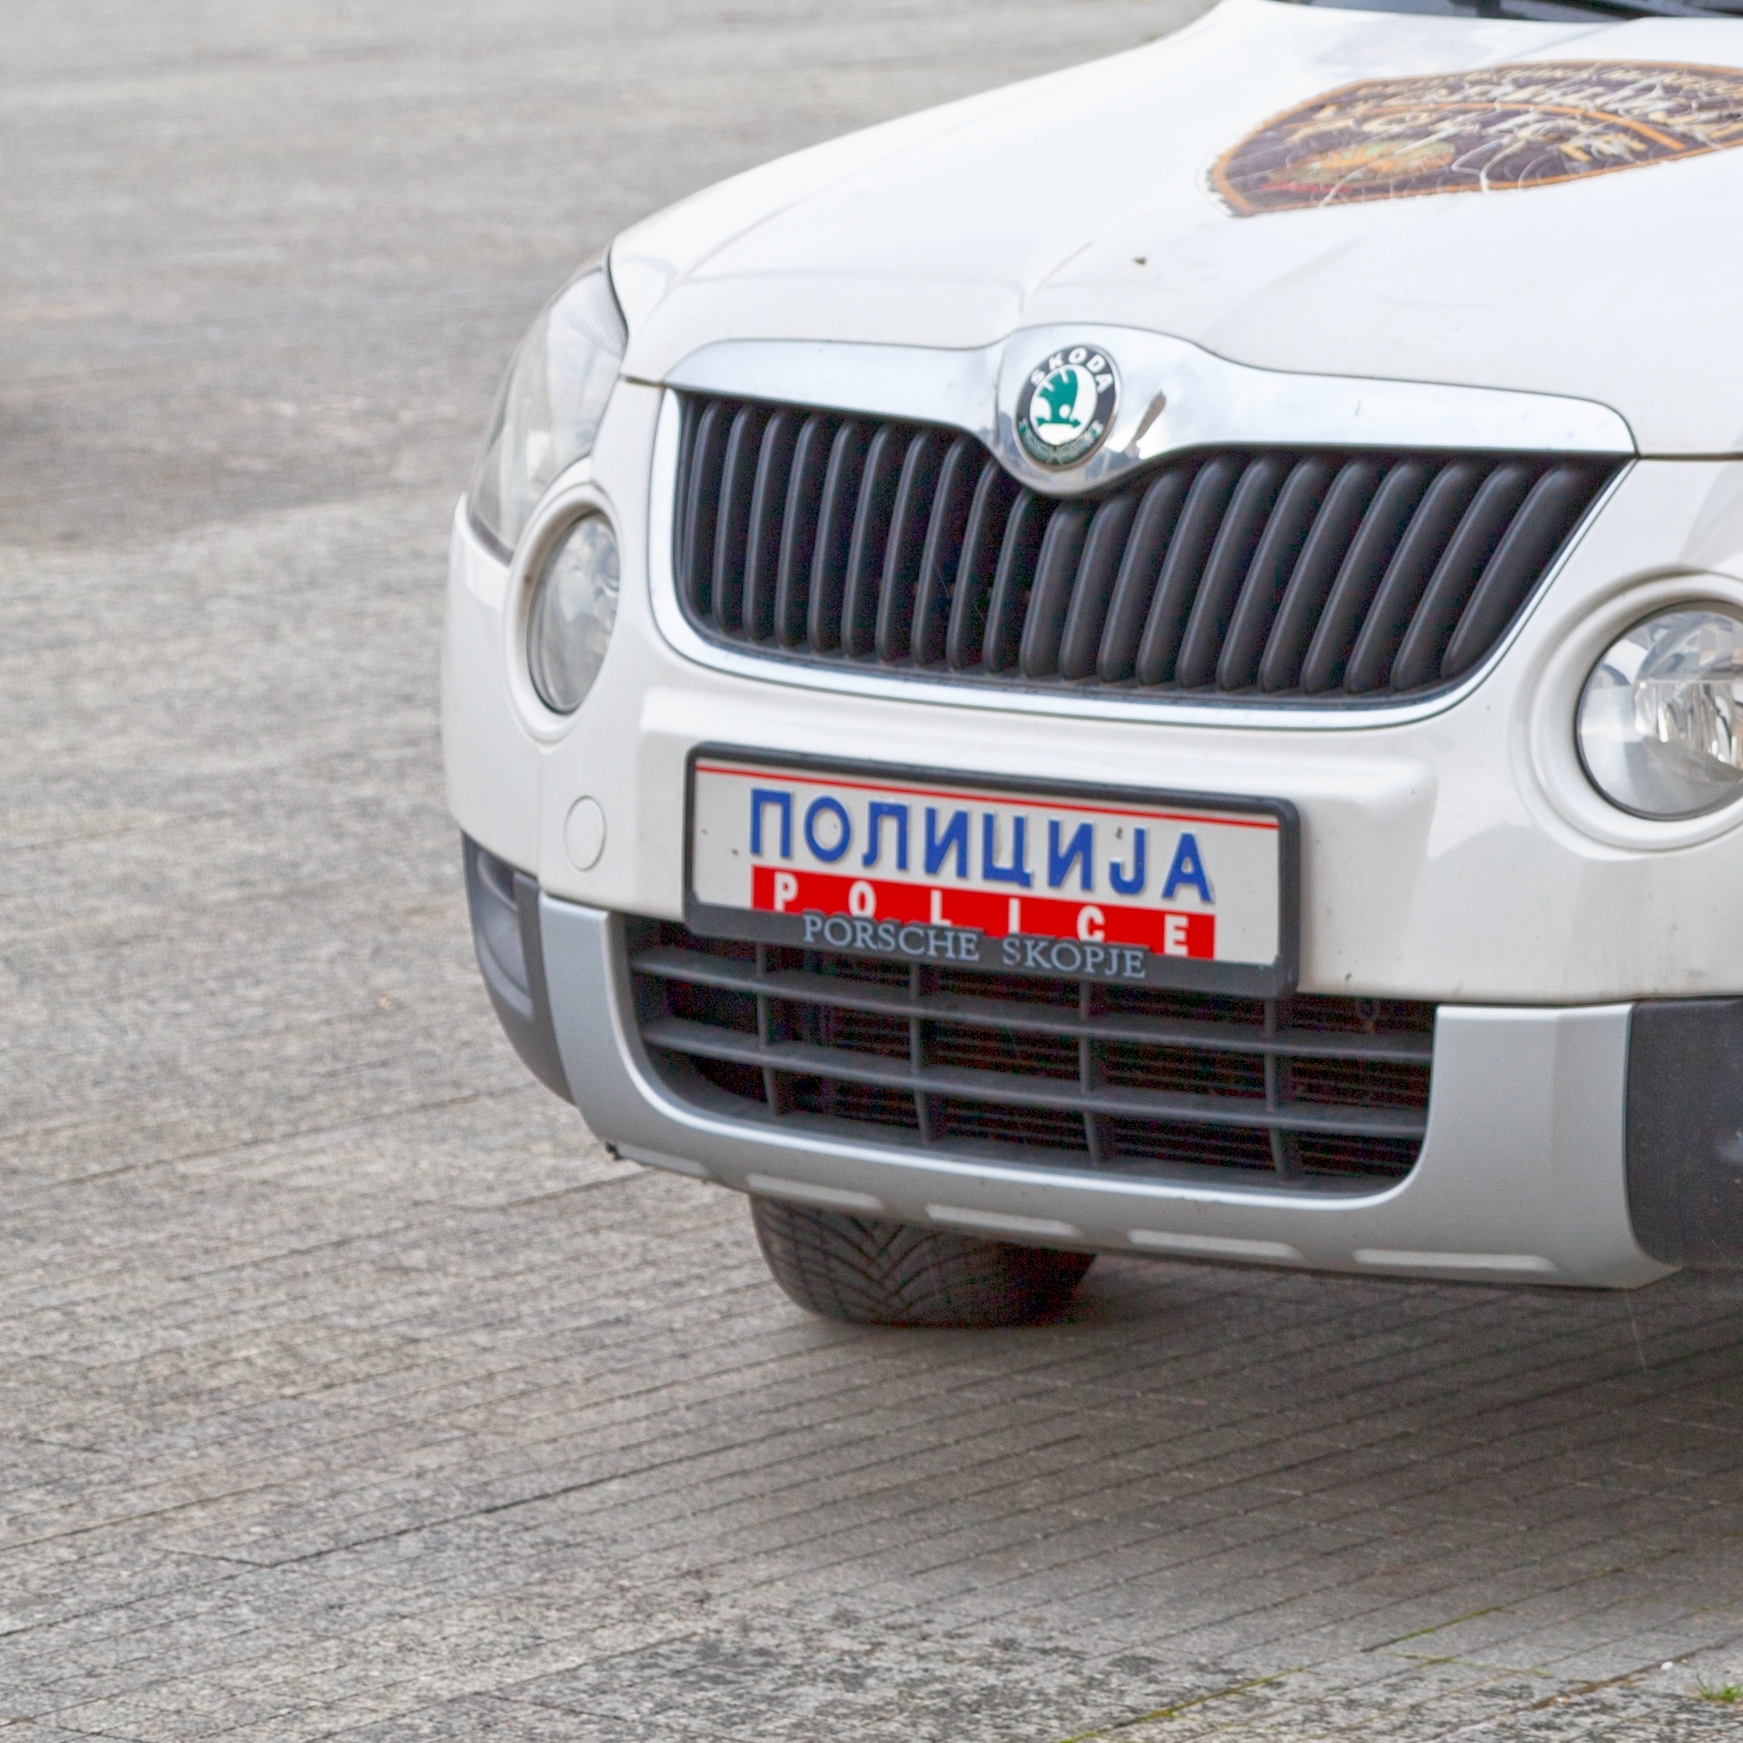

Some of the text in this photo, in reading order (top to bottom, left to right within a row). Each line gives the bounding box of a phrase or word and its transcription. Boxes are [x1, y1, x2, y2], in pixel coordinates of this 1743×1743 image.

[750, 788, 1215, 904] ПОЛИЦИЈА
[773, 871, 1188, 957] POLICE
[803, 913, 1147, 980] PORSCHE SKOPJE
